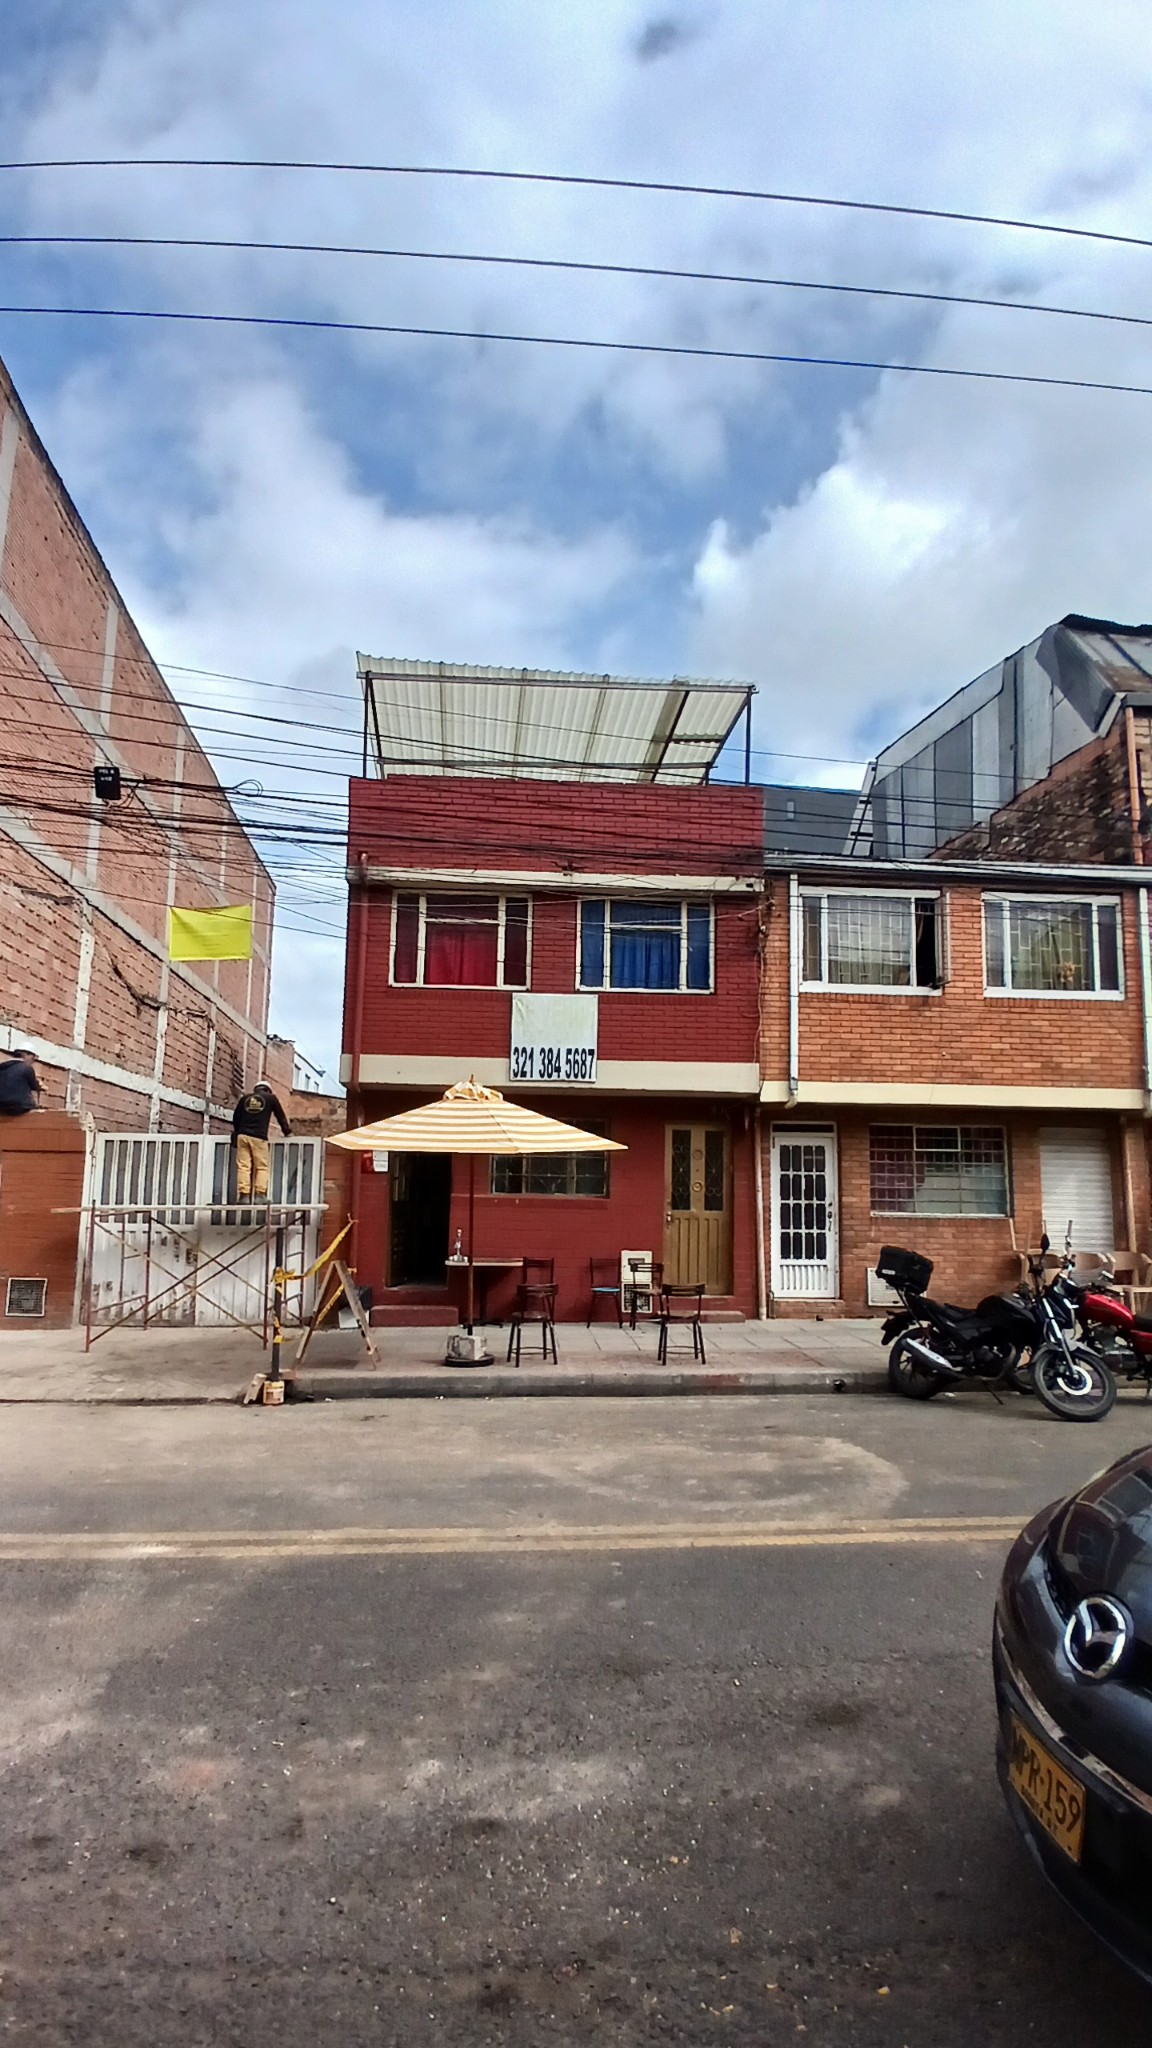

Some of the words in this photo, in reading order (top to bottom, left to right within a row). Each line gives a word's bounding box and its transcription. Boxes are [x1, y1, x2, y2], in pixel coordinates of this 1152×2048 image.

[512, 1046, 535, 1079] 321
[538, 1047, 562, 1079] 384
[565, 1048, 595, 1080] 5687
